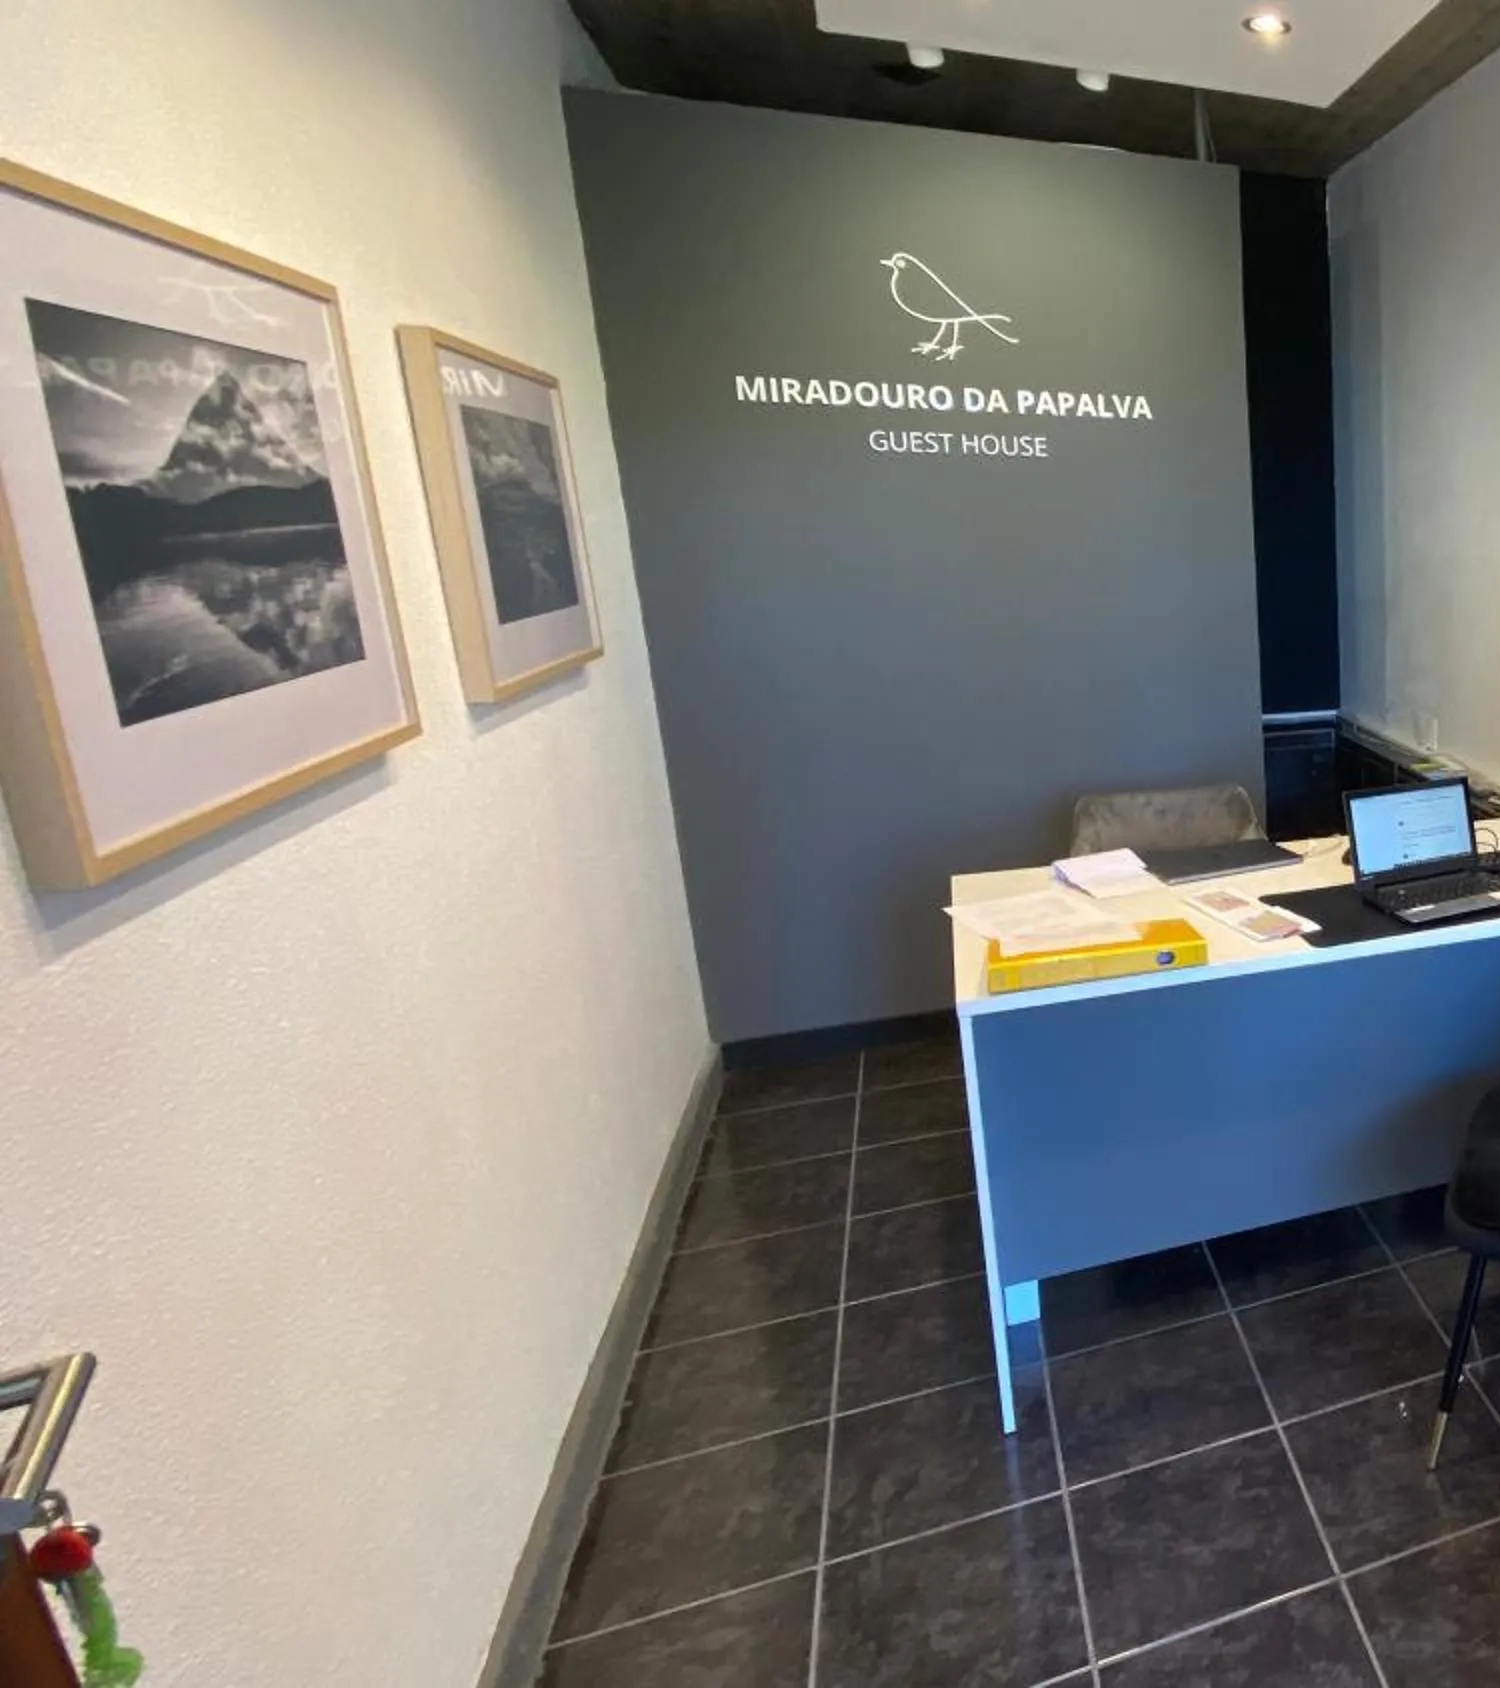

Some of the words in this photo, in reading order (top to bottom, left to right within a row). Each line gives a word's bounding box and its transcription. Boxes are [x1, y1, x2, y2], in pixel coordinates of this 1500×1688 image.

[735, 375, 954, 412] MIRADOURO
[963, 387, 1009, 414] DA
[1017, 389, 1153, 420] PAPALVA
[868, 429, 953, 454] GUEST
[961, 433, 1048, 458] HOUSE
